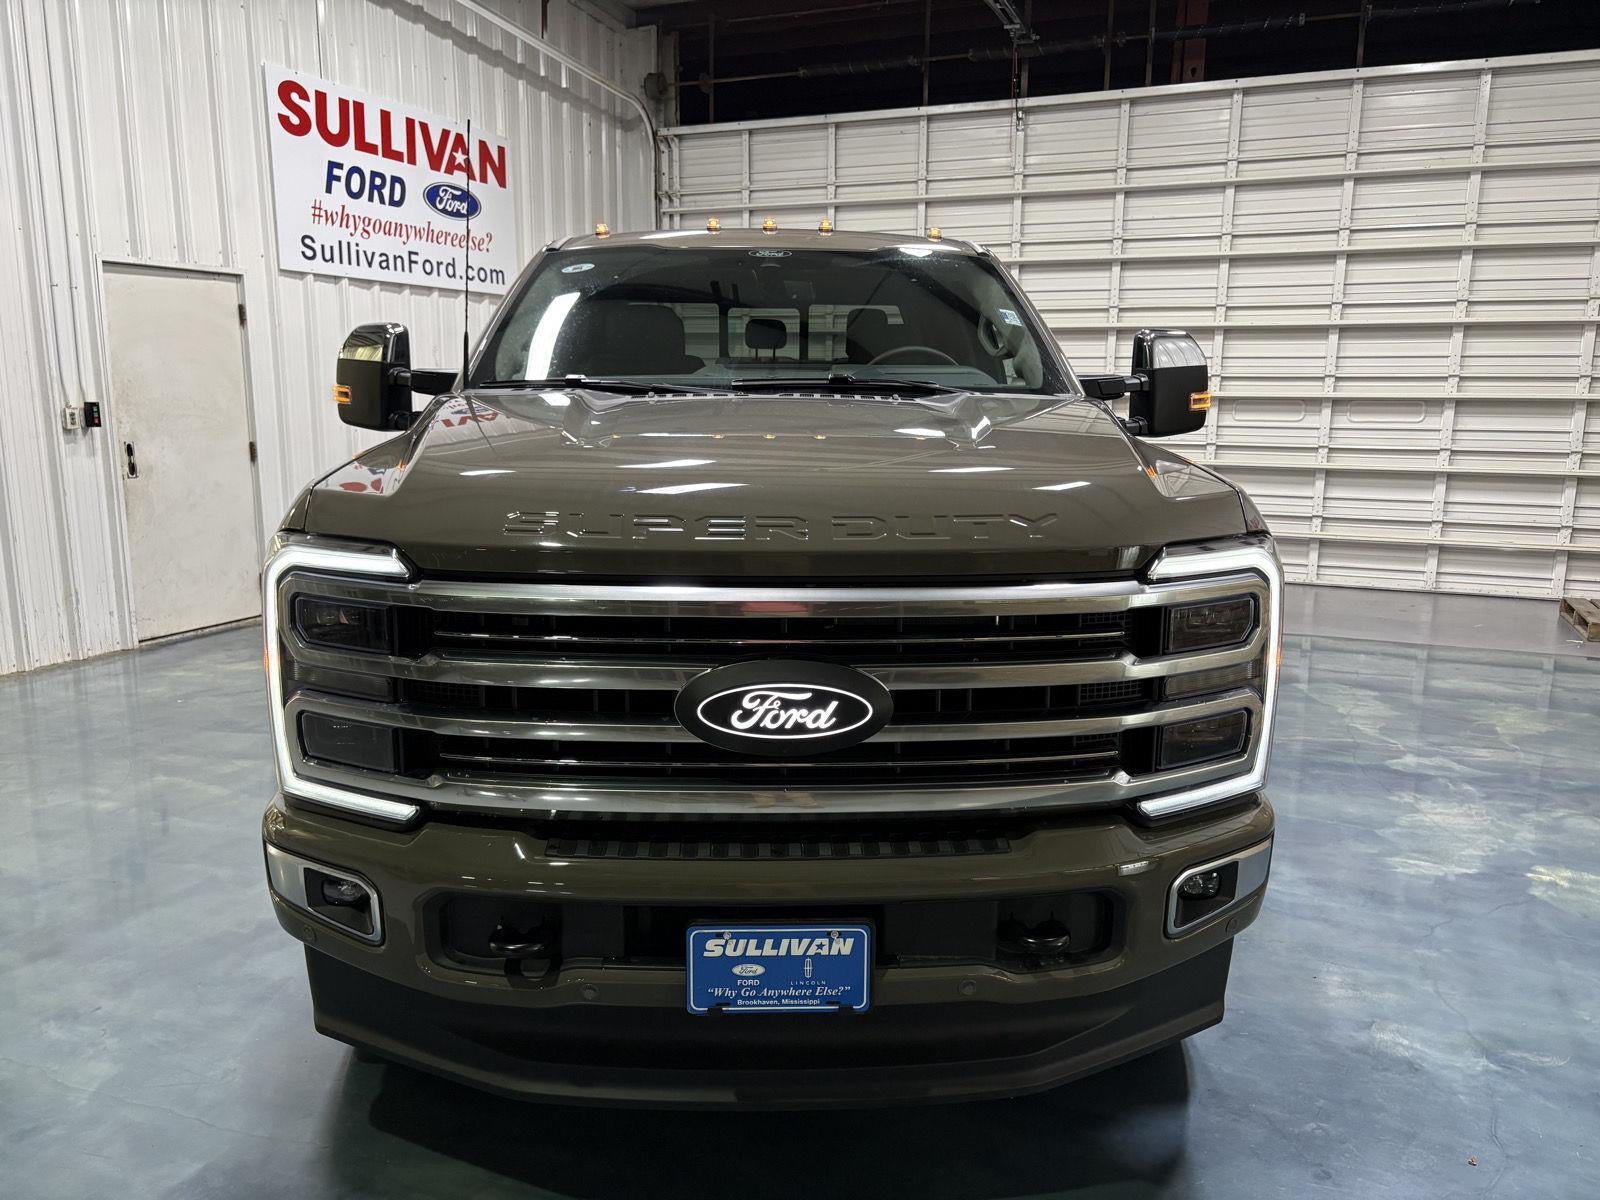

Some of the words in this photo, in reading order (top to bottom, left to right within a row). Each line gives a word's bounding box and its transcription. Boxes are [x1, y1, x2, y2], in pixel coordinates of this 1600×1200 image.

[277, 79, 507, 189] SULLIVAN
[325, 160, 406, 208] FORD
[300, 234, 506, 285] SullivanFord.com
[502, 511, 808, 541] SUPER
[831, 511, 1058, 541] DUTY
[730, 690, 840, 729] Ford
[703, 937, 854, 957] SULLIVAN
[737, 998, 780, 1006] Brookhaven,
[781, 998, 820, 1006] Mississippi
[741, 987, 756, 997] Go
[759, 987, 812, 998] Anywhere
